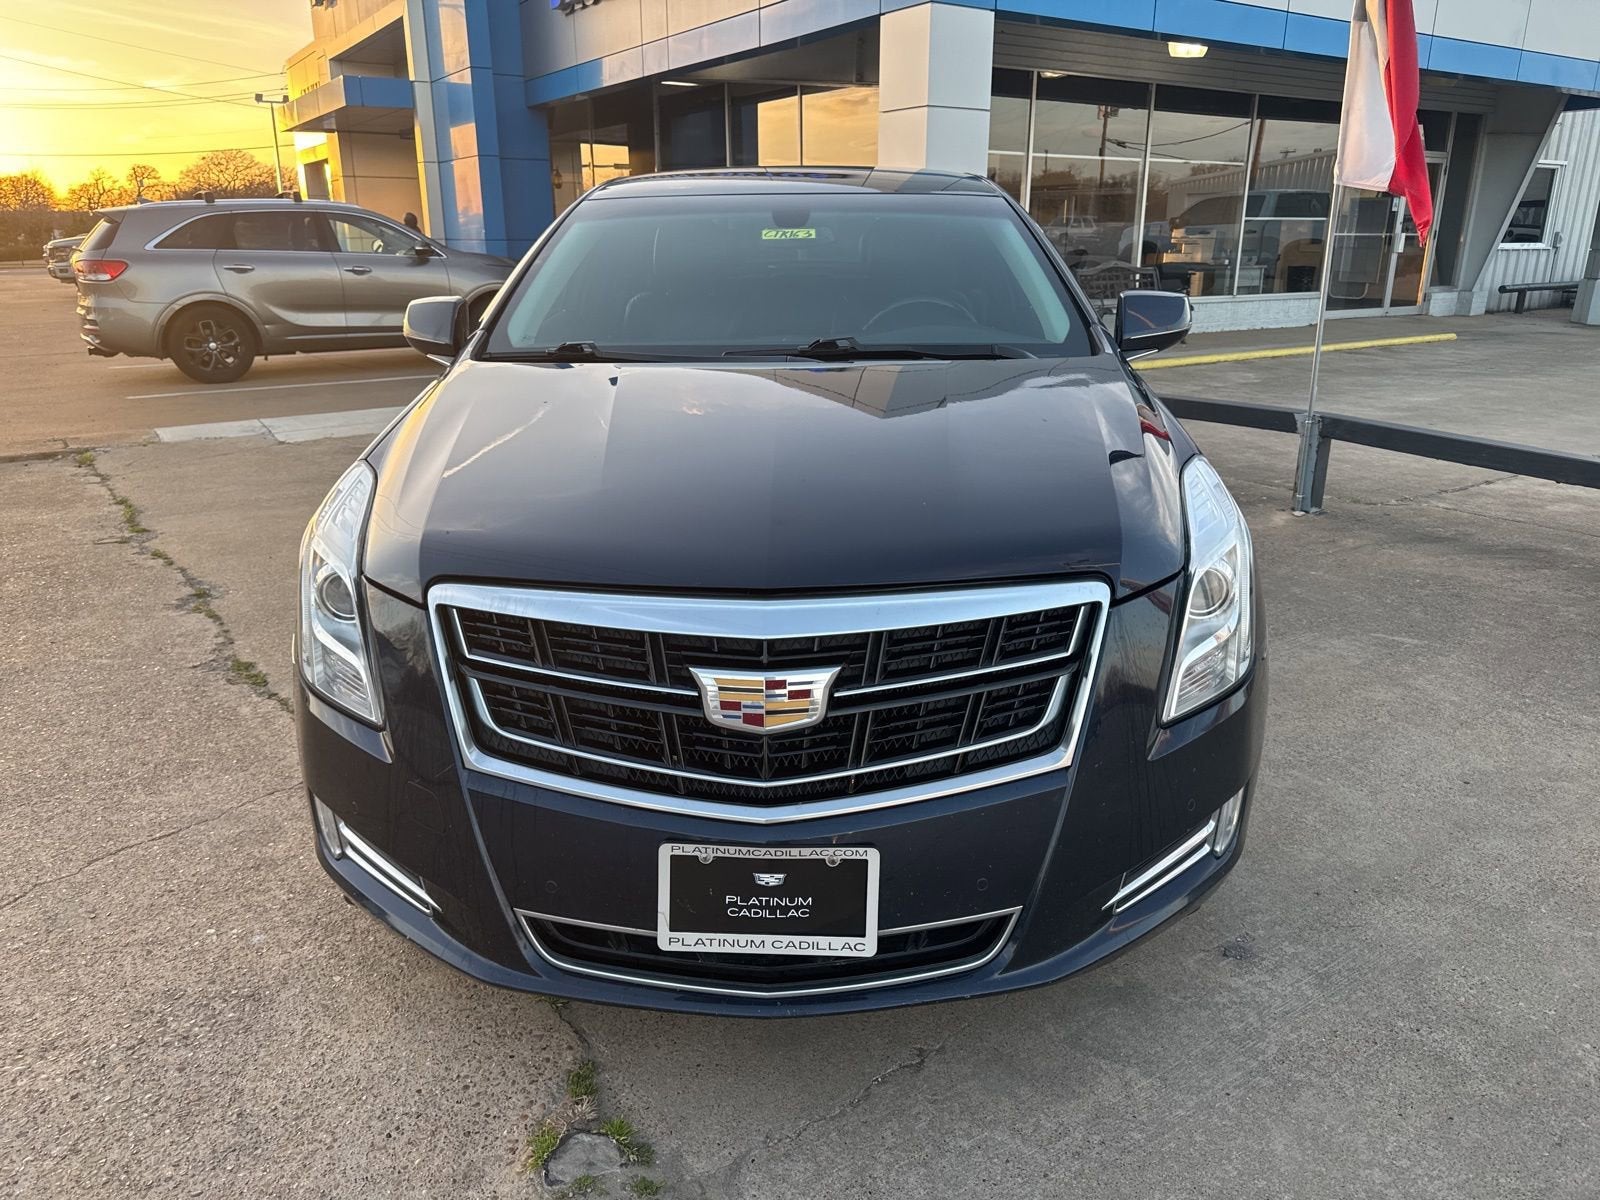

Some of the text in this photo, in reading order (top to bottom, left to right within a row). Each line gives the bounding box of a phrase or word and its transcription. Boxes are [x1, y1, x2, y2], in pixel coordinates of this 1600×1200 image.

[670, 845, 868, 858] PLATINUMCADILLAC.COM
[725, 895, 812, 906] PLATINUM
[727, 908, 810, 918] CADILLAC
[668, 937, 866, 952] PLATINUM CADILLAC
